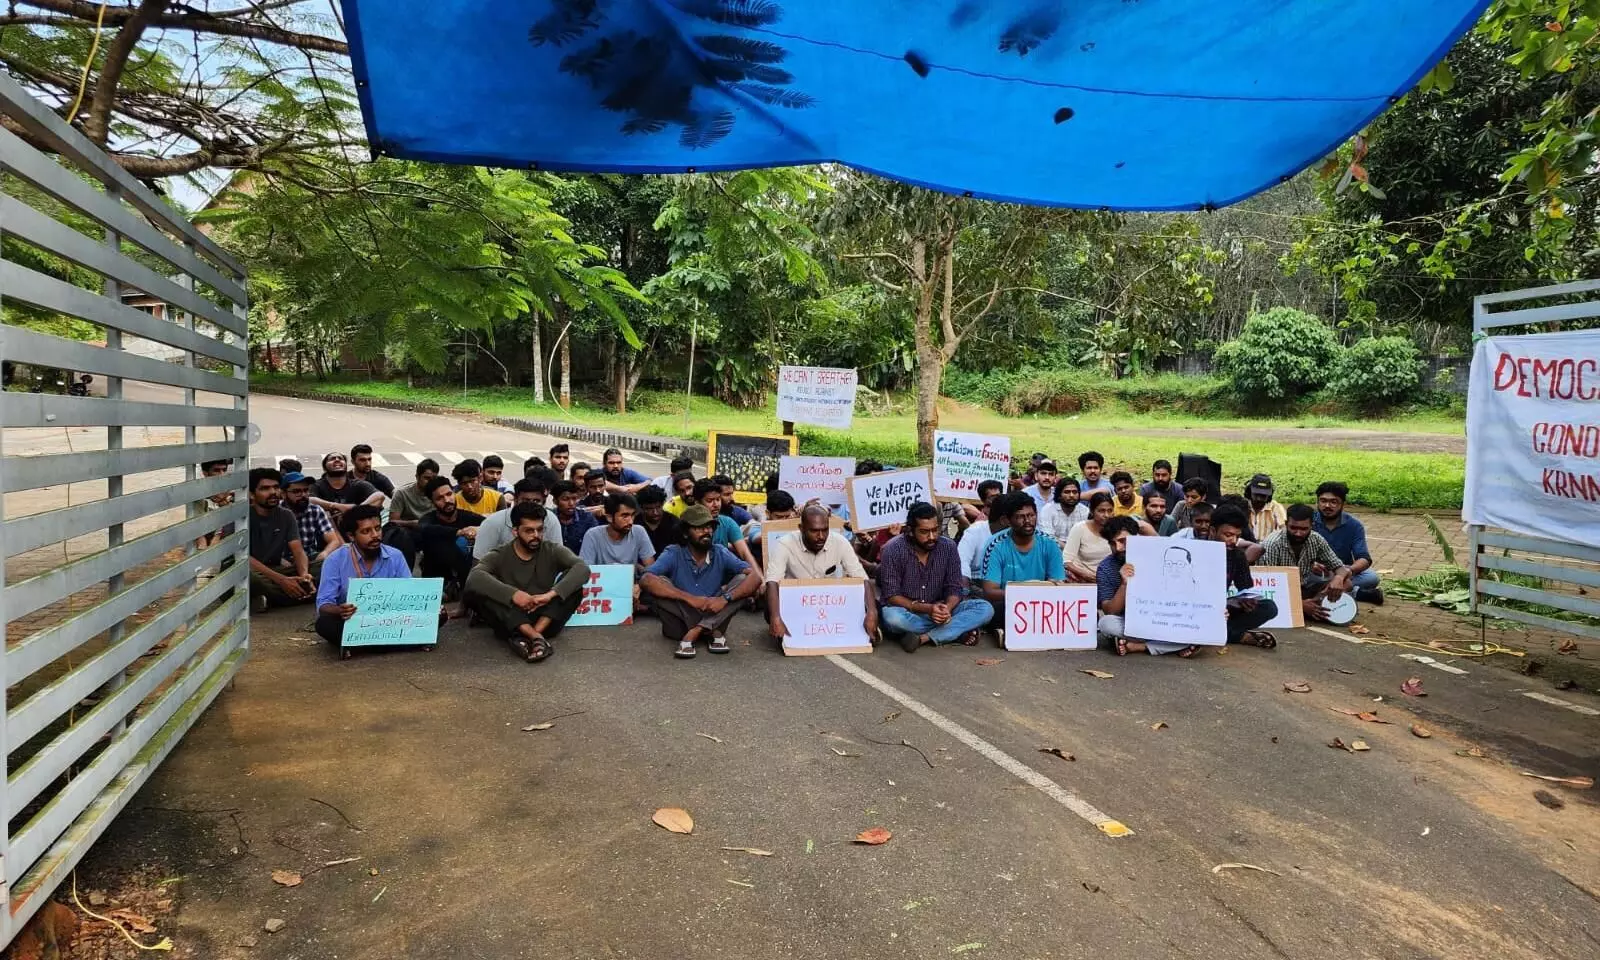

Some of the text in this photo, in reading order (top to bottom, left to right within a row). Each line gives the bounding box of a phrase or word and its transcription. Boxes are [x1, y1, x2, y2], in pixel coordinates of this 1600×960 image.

[1494, 353, 1600, 400] DEMOC
[981, 442, 1009, 463] Fascism
[866, 482, 923, 499] WE NEED A
[802, 594, 846, 606] RESIGN
[818, 608, 827, 620] &
[1014, 600, 1088, 634] STRIKE
[803, 623, 846, 636] LEAVE
